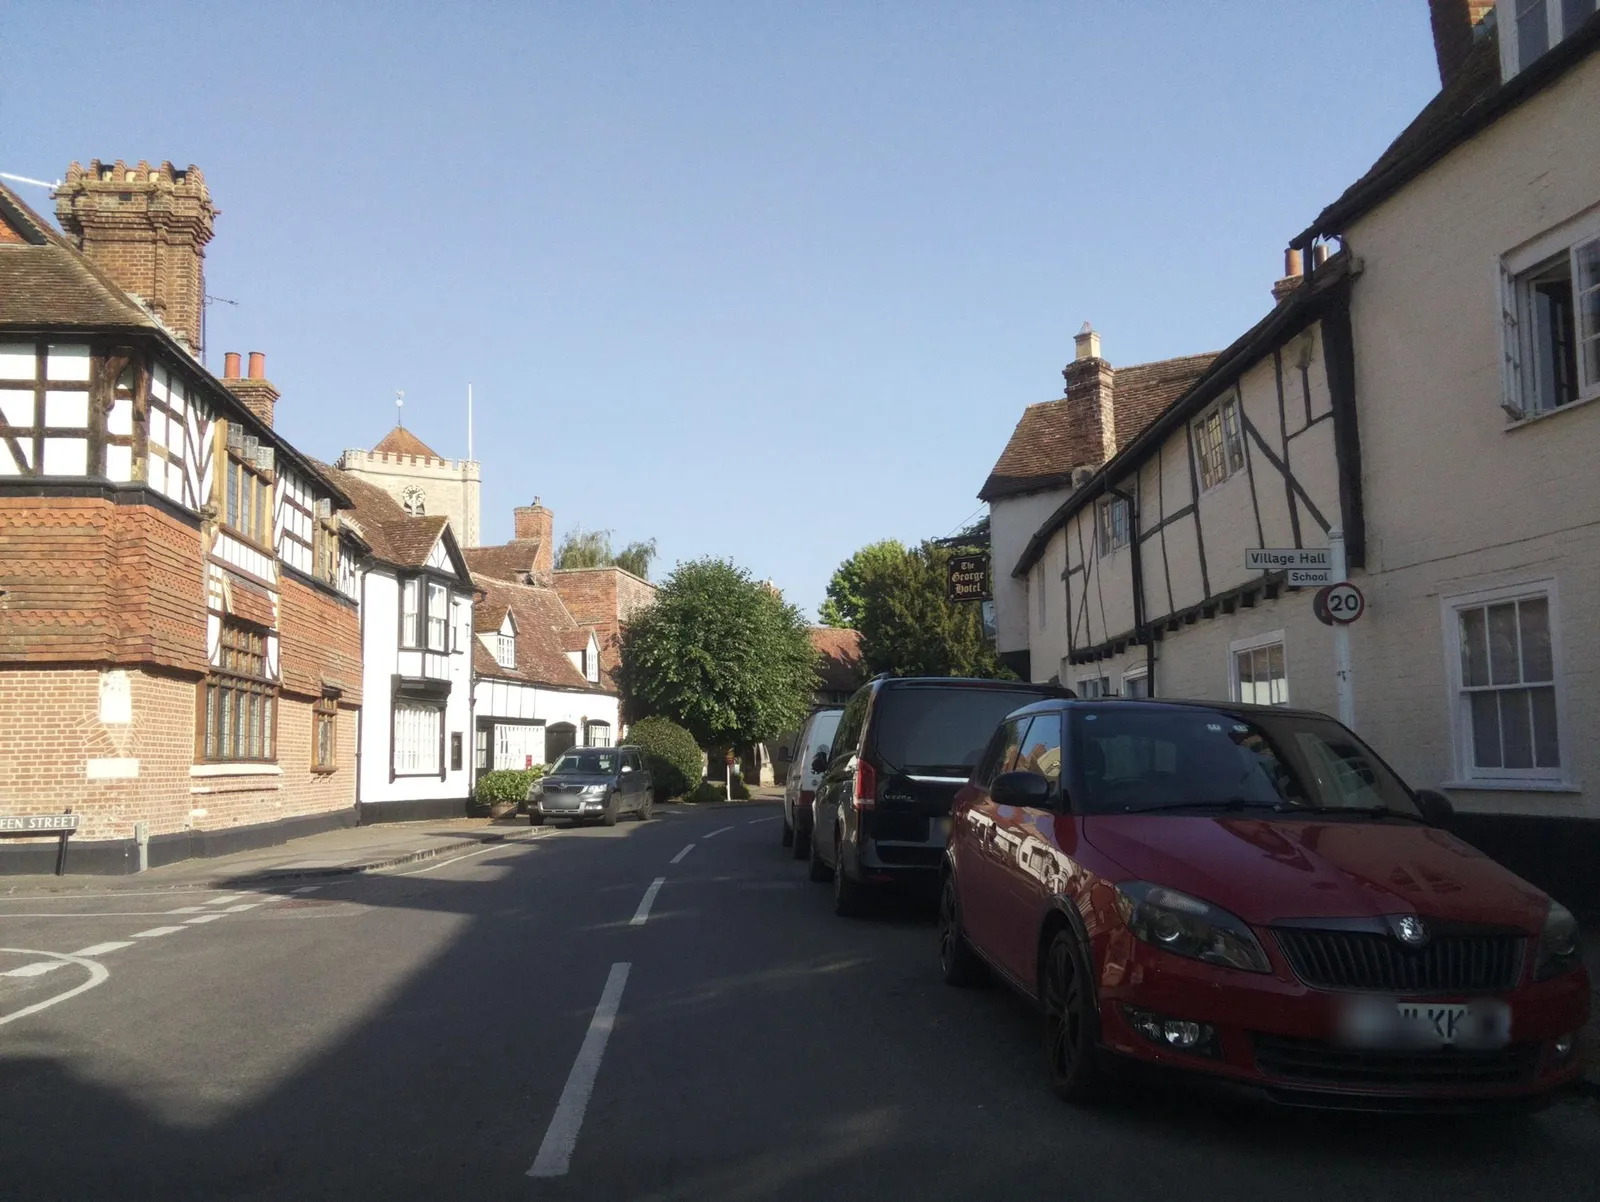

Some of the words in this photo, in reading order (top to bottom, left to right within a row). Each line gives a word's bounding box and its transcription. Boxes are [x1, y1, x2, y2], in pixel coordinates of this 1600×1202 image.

[1251, 553, 1295, 565] Village
[1300, 553, 1326, 564] Hall
[961, 562, 975, 570] The
[952, 572, 984, 582] George
[1292, 572, 1328, 581] School
[955, 582, 981, 595] Hotel
[1330, 594, 1358, 612] 20
[0, 818, 24, 830] EEN
[28, 816, 78, 829] STREET
